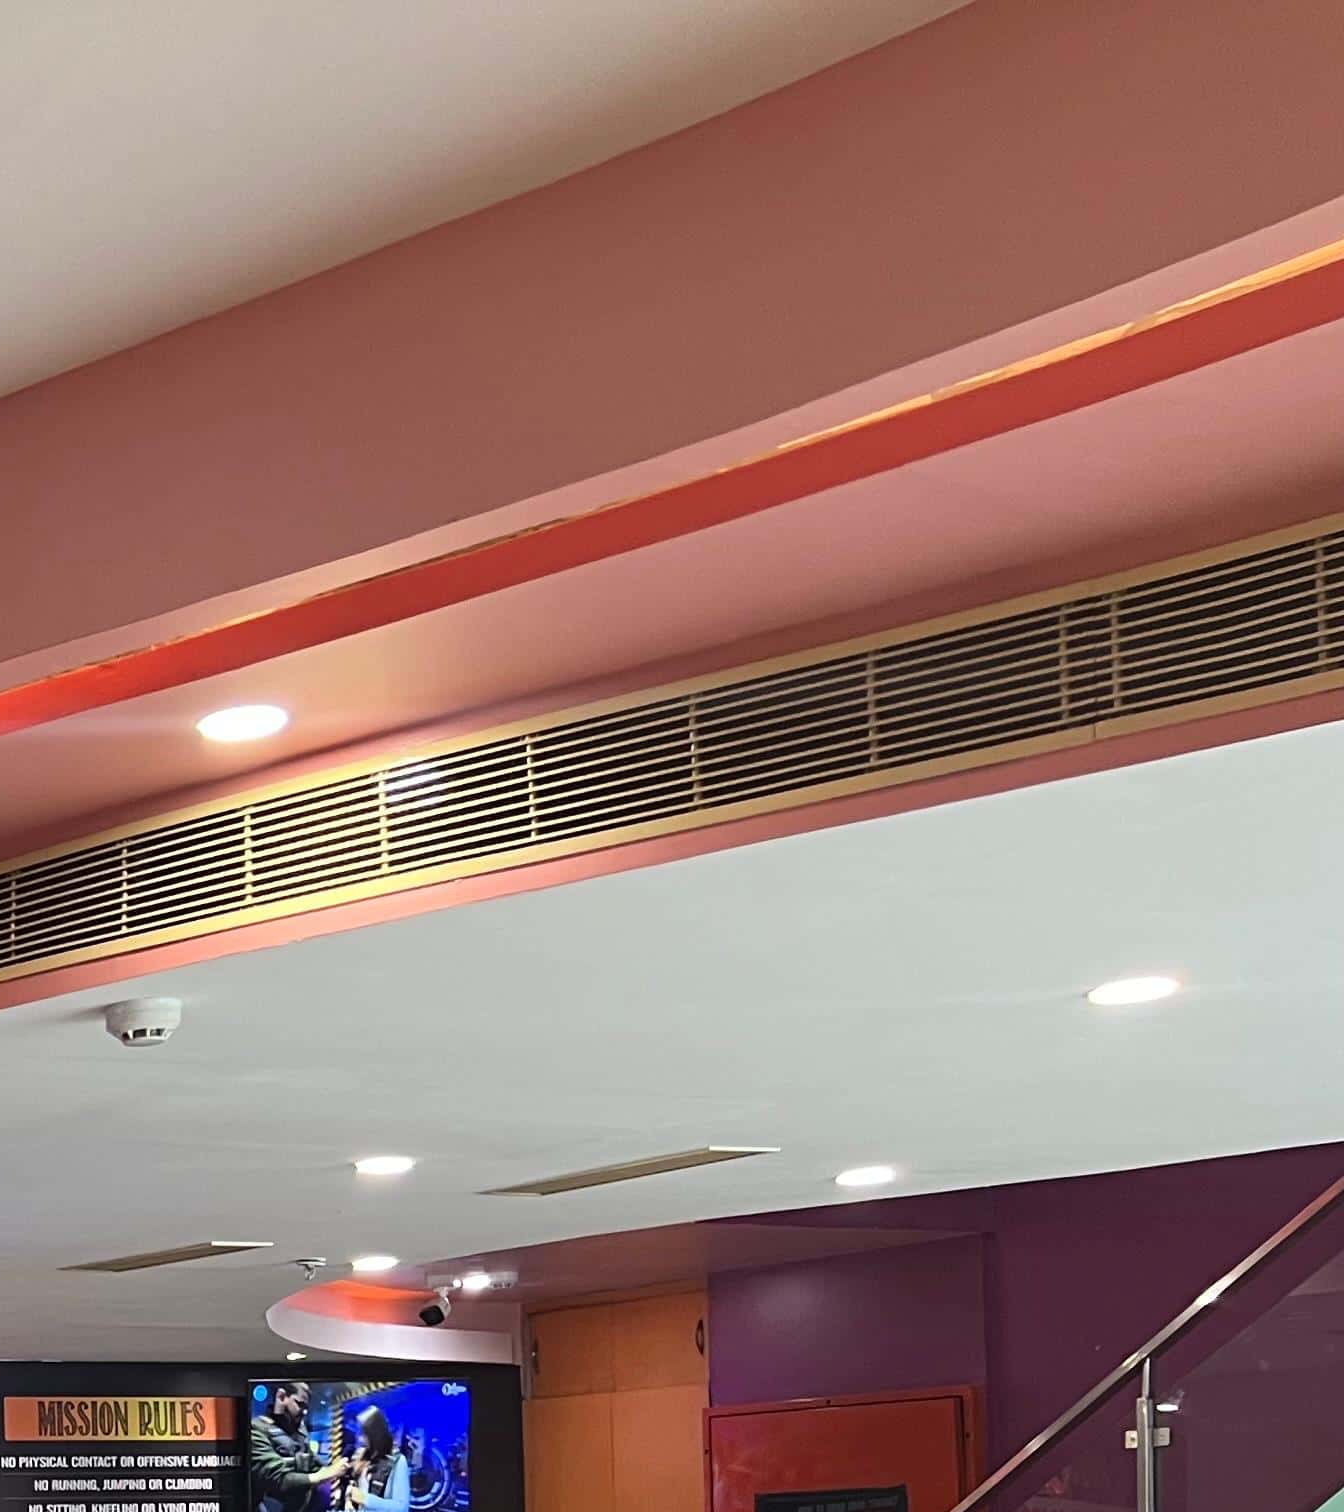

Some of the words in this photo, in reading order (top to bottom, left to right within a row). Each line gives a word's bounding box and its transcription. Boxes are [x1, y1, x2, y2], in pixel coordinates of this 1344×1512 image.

[37, 1400, 129, 1437] MISSION
[138, 1400, 206, 1436] RULES
[1, 1457, 16, 1469] NO
[19, 1457, 69, 1468] PHYSICAL
[71, 1456, 117, 1468] CONTACT
[121, 1456, 134, 1467] OR
[137, 1456, 189, 1467] OFFENSIVE
[34, 1479, 48, 1491] NO
[102, 1479, 146, 1491] JUMPING
[149, 1479, 162, 1490] OR
[165, 1478, 213, 1490] CLIMBING
